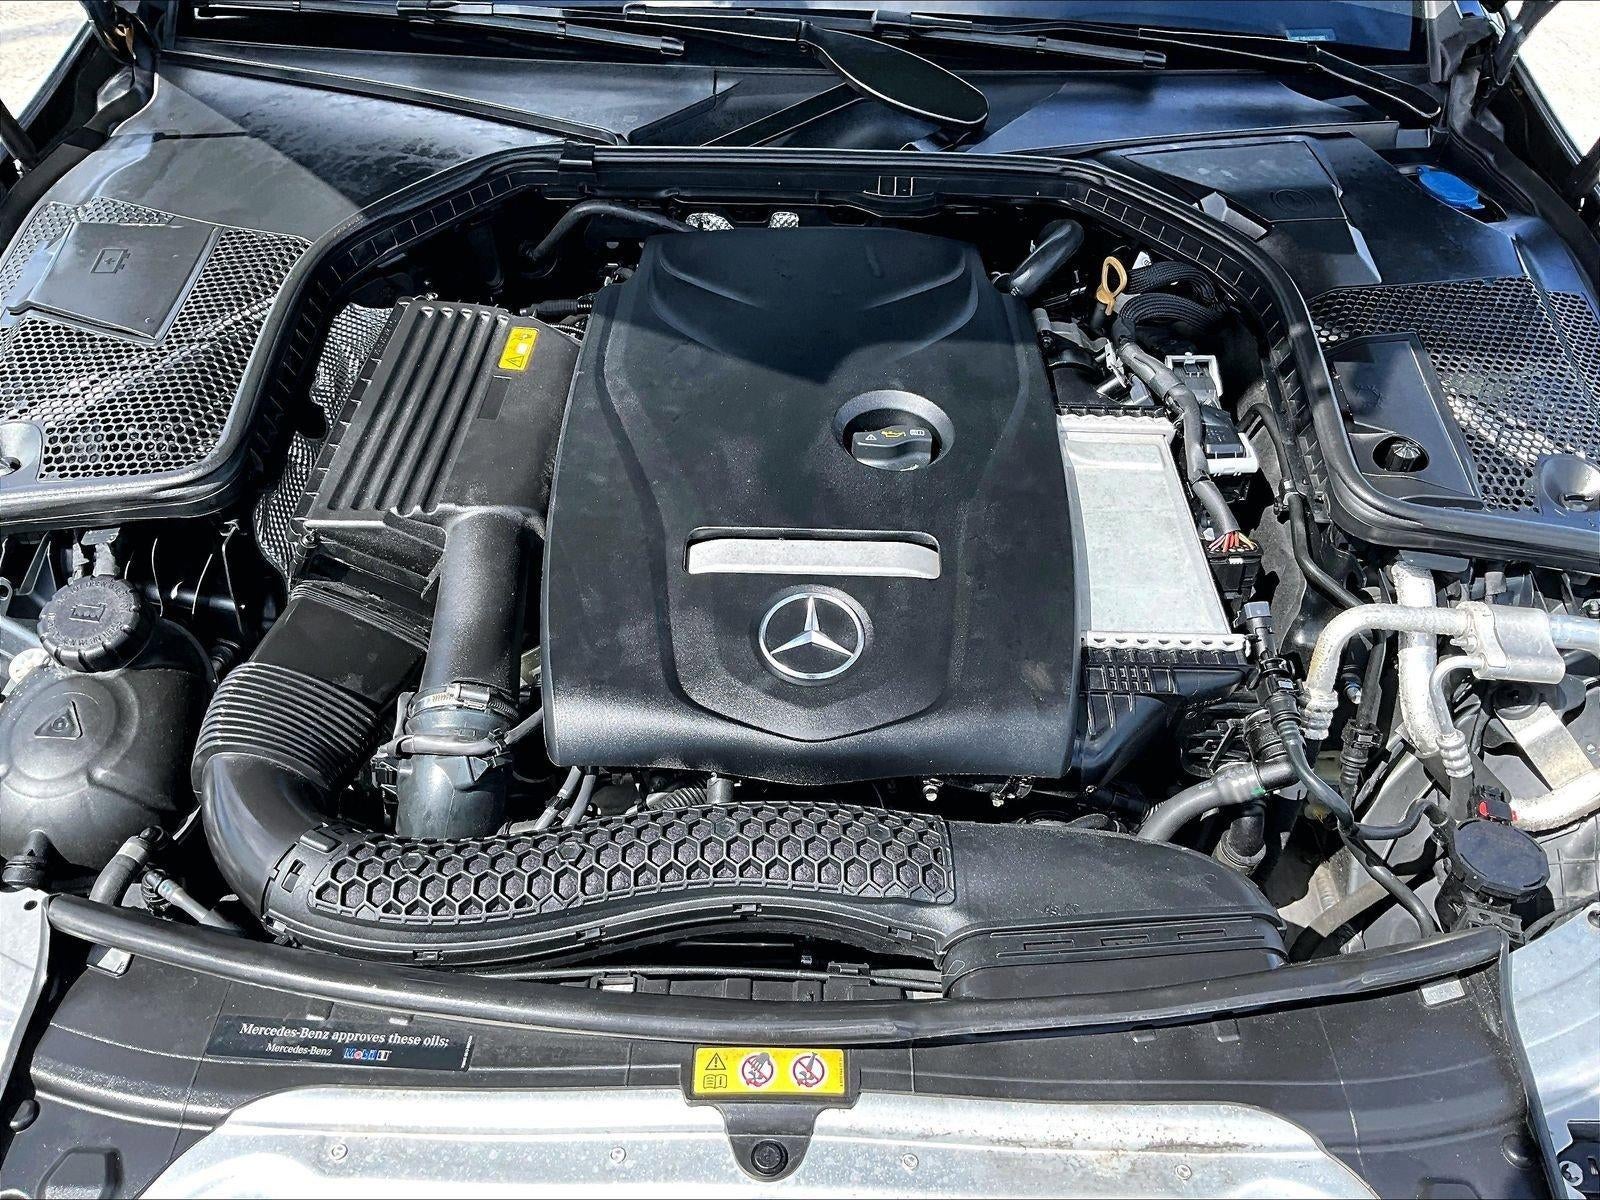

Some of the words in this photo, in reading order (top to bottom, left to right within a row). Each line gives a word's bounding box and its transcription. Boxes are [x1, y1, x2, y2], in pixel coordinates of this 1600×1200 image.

[239, 1023, 329, 1040] Mercedes-Benz
[331, 1028, 386, 1043] approves
[388, 1032, 422, 1046] these
[265, 1042, 333, 1056] Mercedes-Benz
[343, 1047, 377, 1060] Mobil
